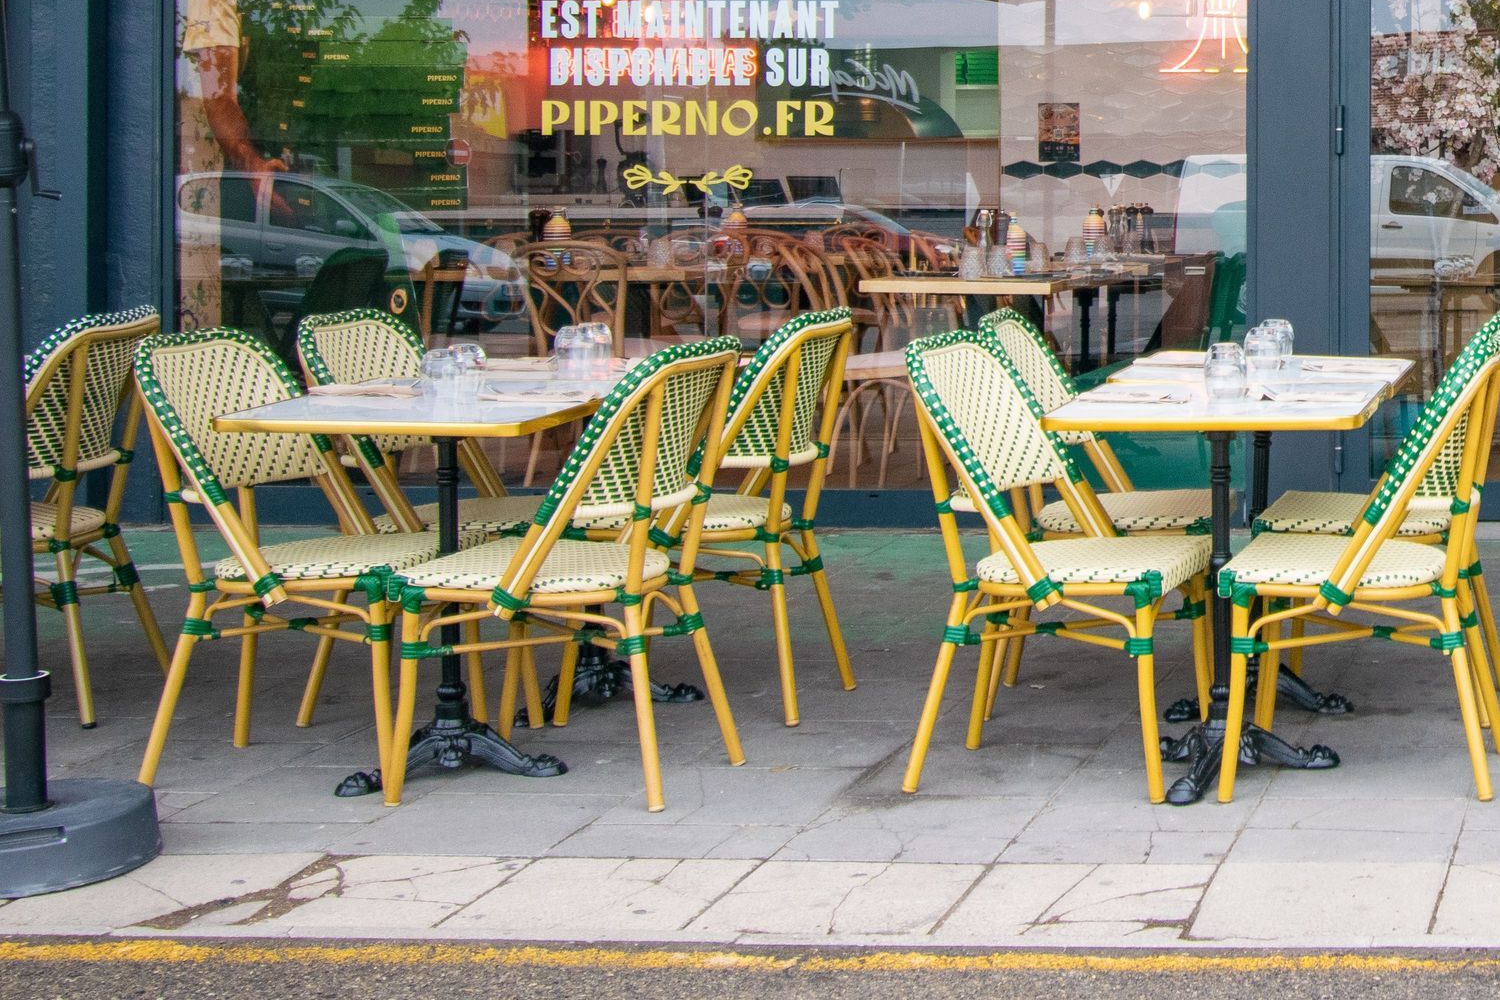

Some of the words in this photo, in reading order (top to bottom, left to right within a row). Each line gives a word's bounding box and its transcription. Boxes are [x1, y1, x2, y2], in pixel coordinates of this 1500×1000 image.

[541, 0, 600, 39] EST
[619, 0, 839, 39] MAINTENANT
[550, 47, 750, 87] DISPONIBLE
[765, 47, 830, 87] SUR
[541, 100, 835, 136] PIPERNO.FR
